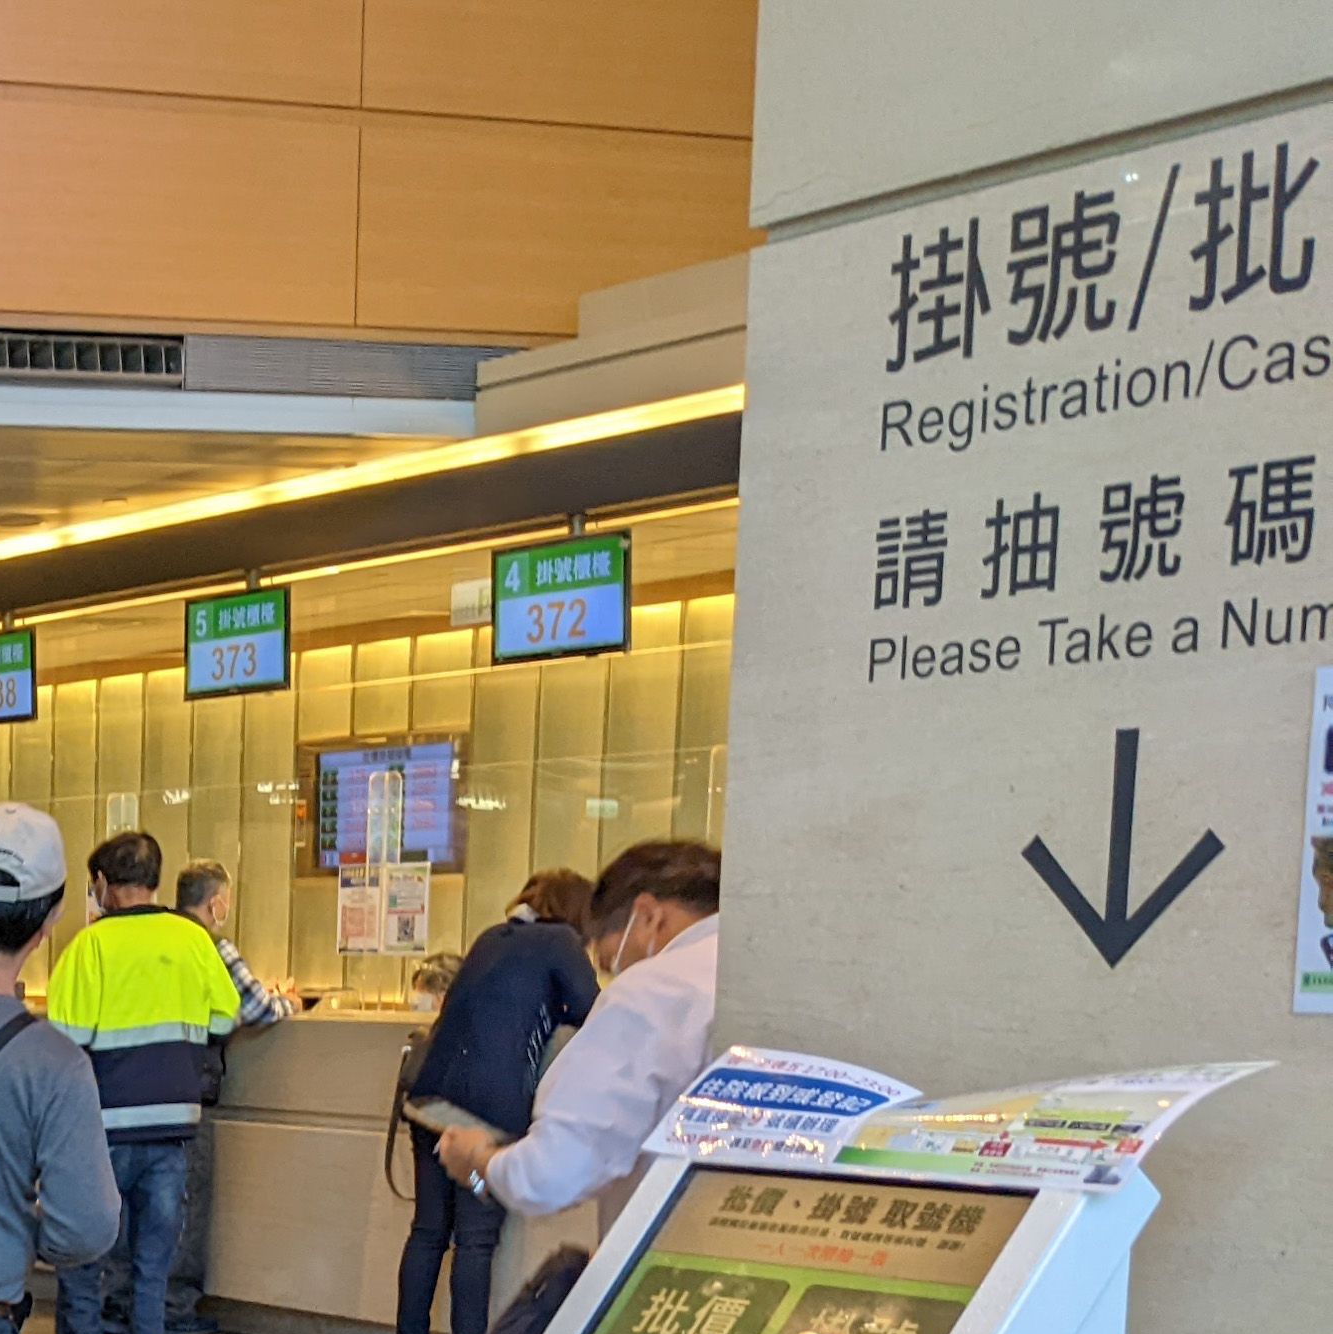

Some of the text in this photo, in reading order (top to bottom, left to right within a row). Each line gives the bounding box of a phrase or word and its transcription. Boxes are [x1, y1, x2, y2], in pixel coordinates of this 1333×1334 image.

[885, 142, 1320, 373] 掛號/批
[880, 334, 1332, 452] Registration/Cas
[873, 454, 1316, 611] 請抽號碼
[504, 560, 521, 591] 4
[195, 609, 208, 638] 5
[526, 598, 588, 643] 372
[868, 634, 1022, 683] Please
[1039, 614, 1153, 666] Take
[1170, 616, 1199, 654] a
[211, 642, 257, 681] 373
